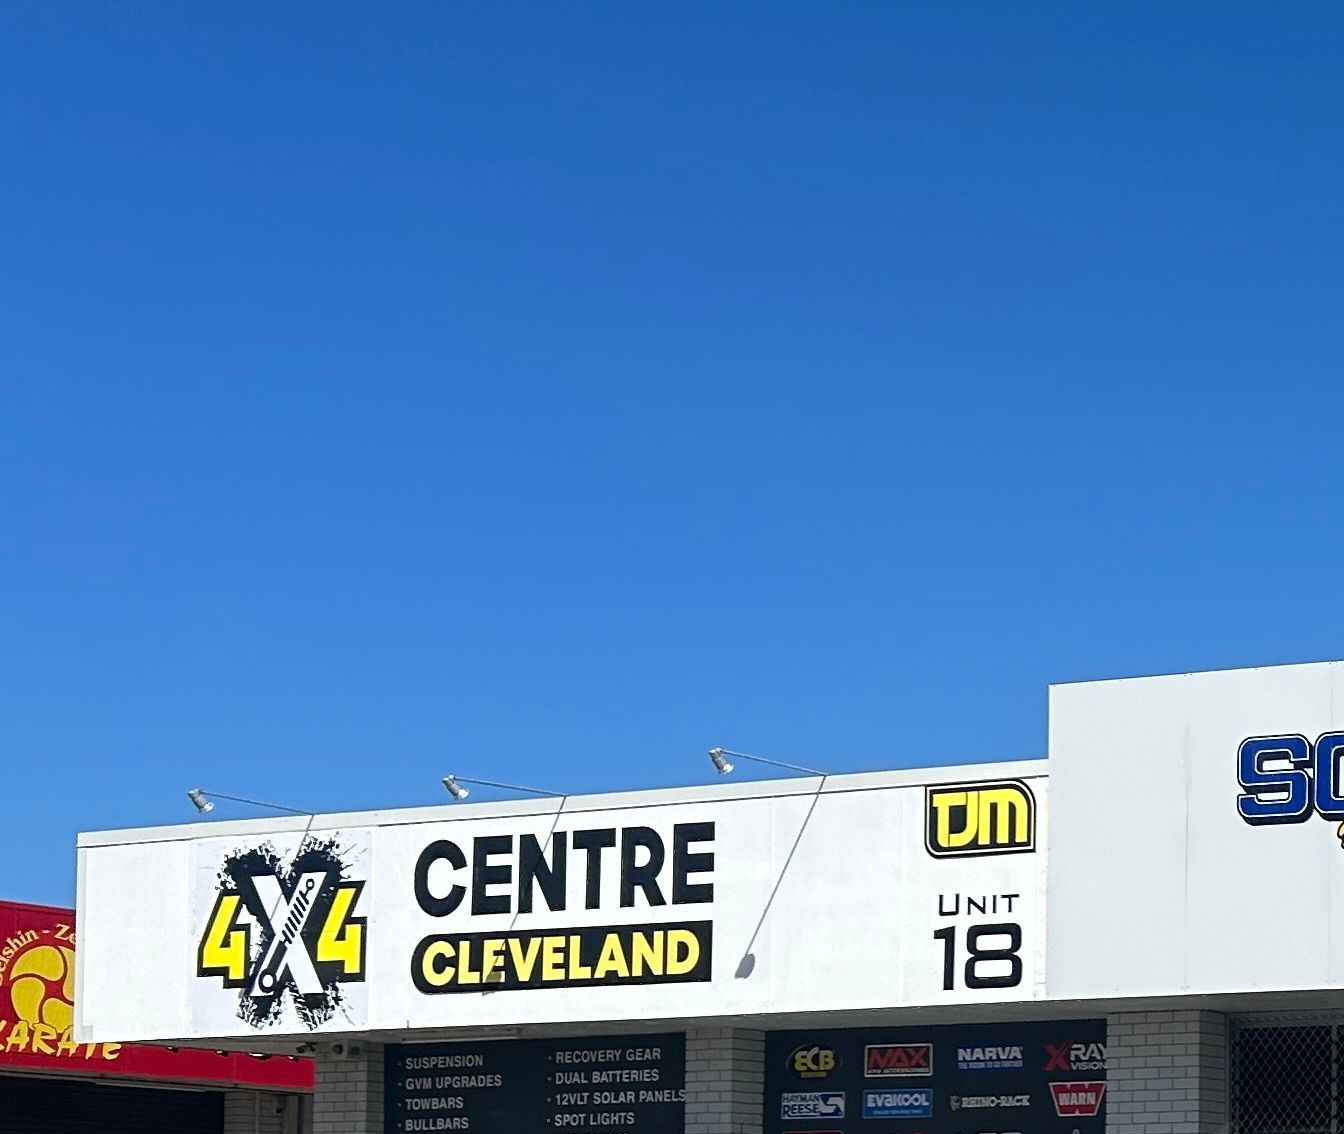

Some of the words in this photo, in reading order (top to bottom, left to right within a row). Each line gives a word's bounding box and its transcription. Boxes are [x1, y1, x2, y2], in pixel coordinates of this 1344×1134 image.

[932, 788, 1028, 848] TJM
[414, 821, 716, 918] CENTRE
[938, 893, 1020, 916] UNIT
[0, 929, 39, 986] eishin
[421, 929, 701, 987] CLEVELAND
[933, 922, 1023, 991] 18
[555, 1050, 623, 1064] RECOVERY
[626, 1047, 661, 1061] GEAR
[869, 1048, 928, 1069] MAX
[957, 1046, 1023, 1061] NARVA
[405, 1055, 483, 1069] SUSPENSION
[405, 1078, 432, 1090] GVM
[435, 1075, 502, 1089] UPGRADES
[555, 1071, 588, 1085] DUAL
[592, 1069, 660, 1083] BATTERIES
[405, 1097, 464, 1110] TOWBARS
[555, 1093, 589, 1105] 12VLT
[593, 1091, 635, 1104] SOLAR
[638, 1089, 687, 1103] PANELS
[961, 1095, 1031, 1108] RHINO-RACK
[1058, 1092, 1096, 1106] WARN
[782, 1103, 820, 1117] REESE
[405, 1118, 469, 1131] BULLBARS
[554, 1114, 586, 1127] SPOT
[589, 1112, 635, 1126] LIGHTS
